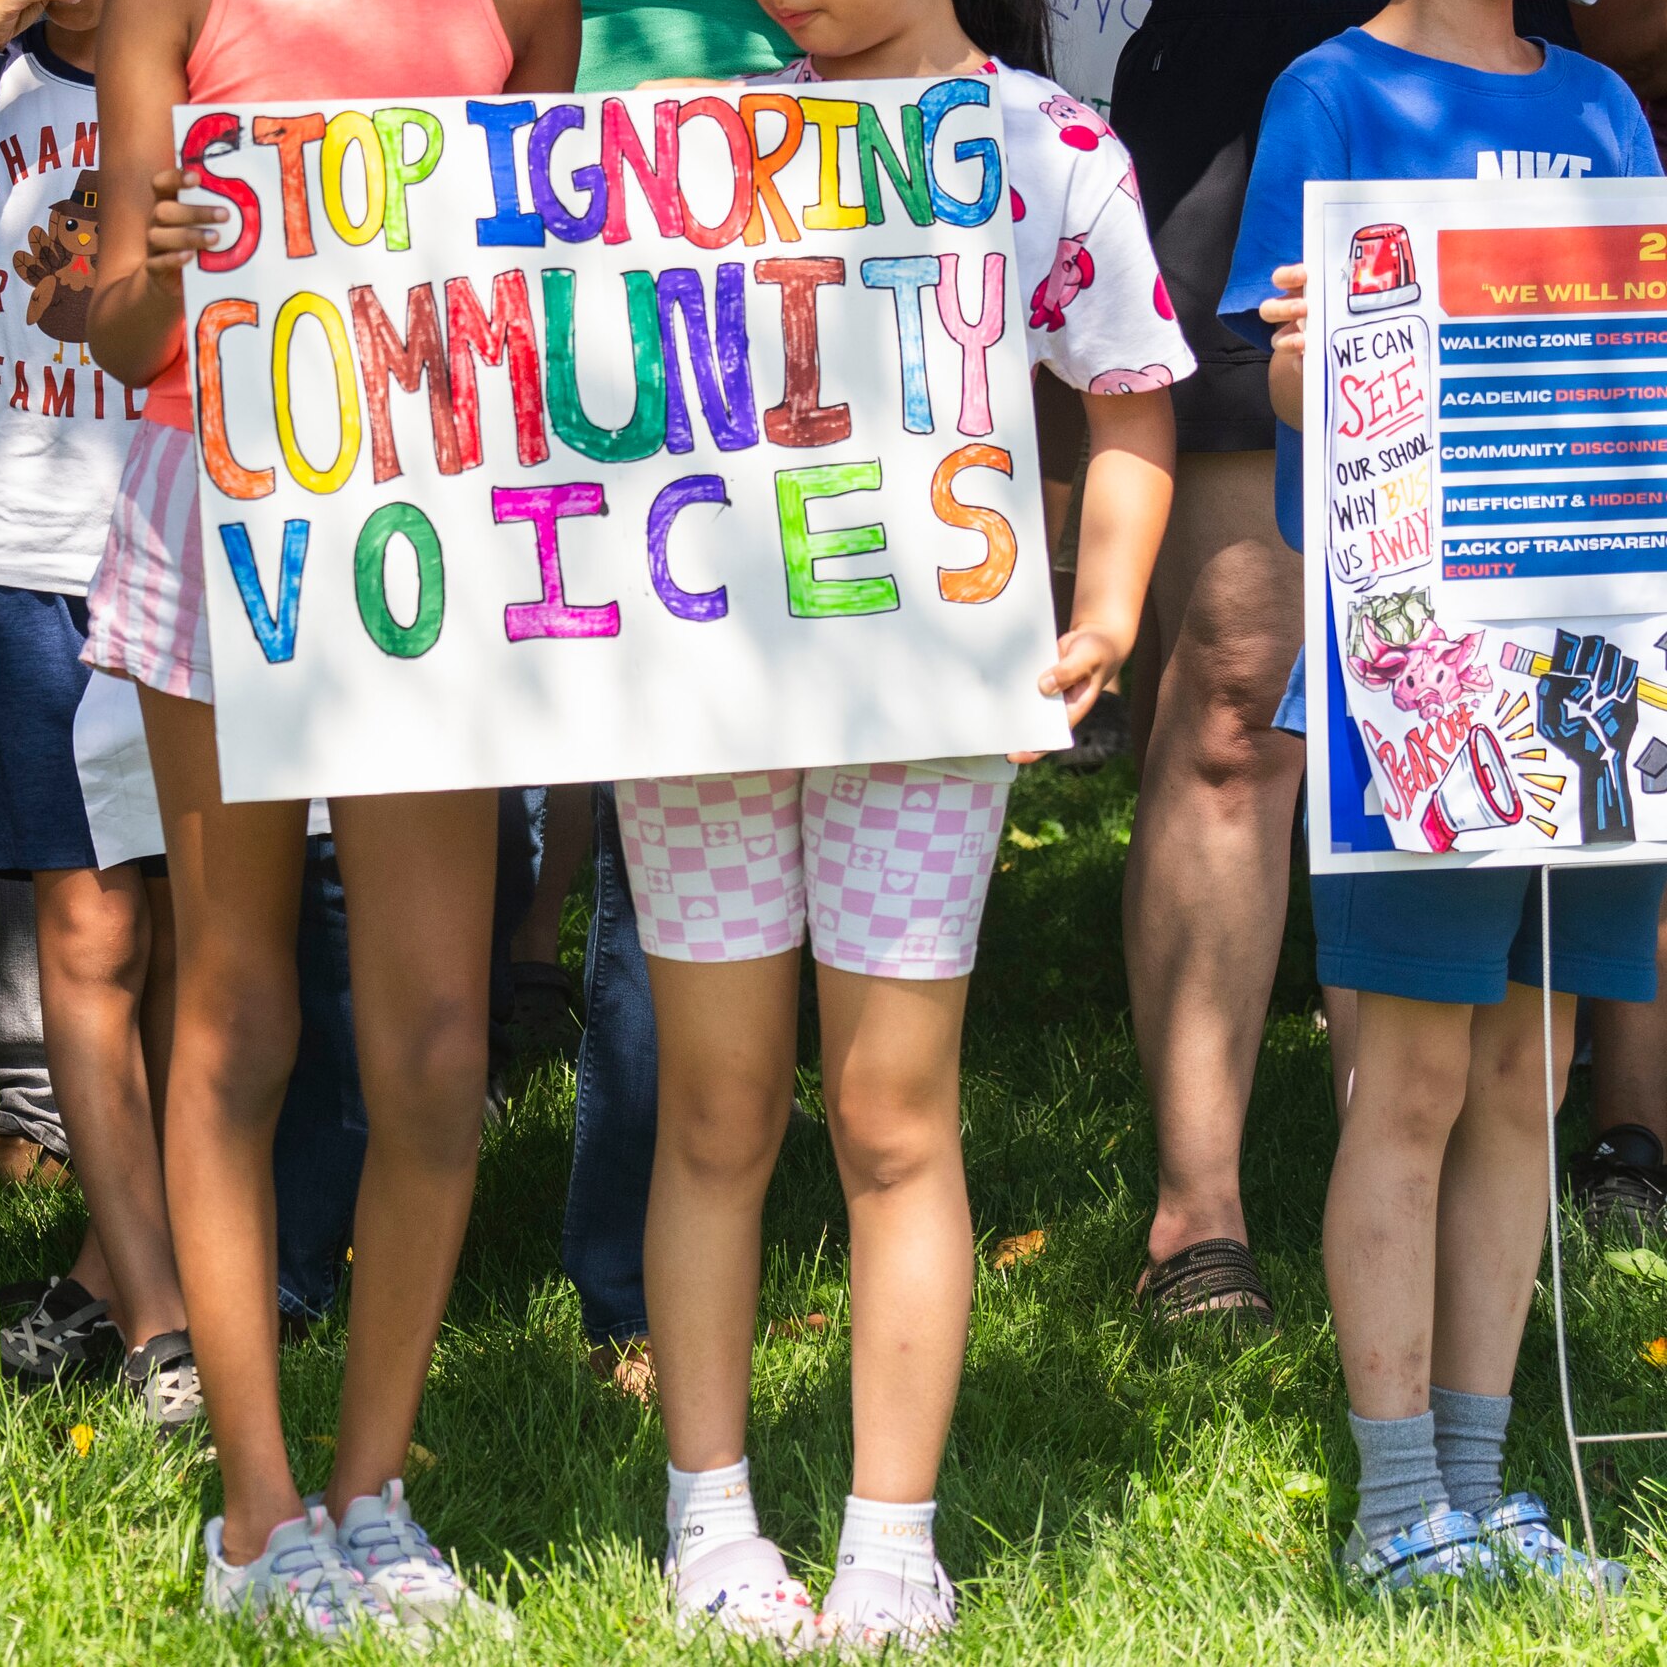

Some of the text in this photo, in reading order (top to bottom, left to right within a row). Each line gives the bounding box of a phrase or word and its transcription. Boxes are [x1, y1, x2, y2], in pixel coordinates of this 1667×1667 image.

[178, 77, 1003, 274] STOP IGNORING
[1544, 284, 1618, 303] WILL
[1333, 325, 1415, 369] WE CAN
[1441, 334, 1537, 351] WALKING
[1540, 333, 1593, 347] ZONE
[196, 251, 1007, 501] COMMUNITY
[1338, 355, 1424, 439] SEE
[1442, 389, 1553, 407] ACADEMIC
[1441, 443, 1567, 460] COMMUNITY
[1336, 456, 1377, 487] OUR
[1333, 464, 1429, 533] WHY BUS
[1445, 491, 1663, 513] INEFFICIENT & HIDDEN
[218, 441, 1017, 664] VOICES
[1336, 543, 1363, 576] US
[1444, 542, 1502, 558] LACK
[1505, 540, 1530, 554] OF
[1444, 562, 1516, 579] EQUITY
